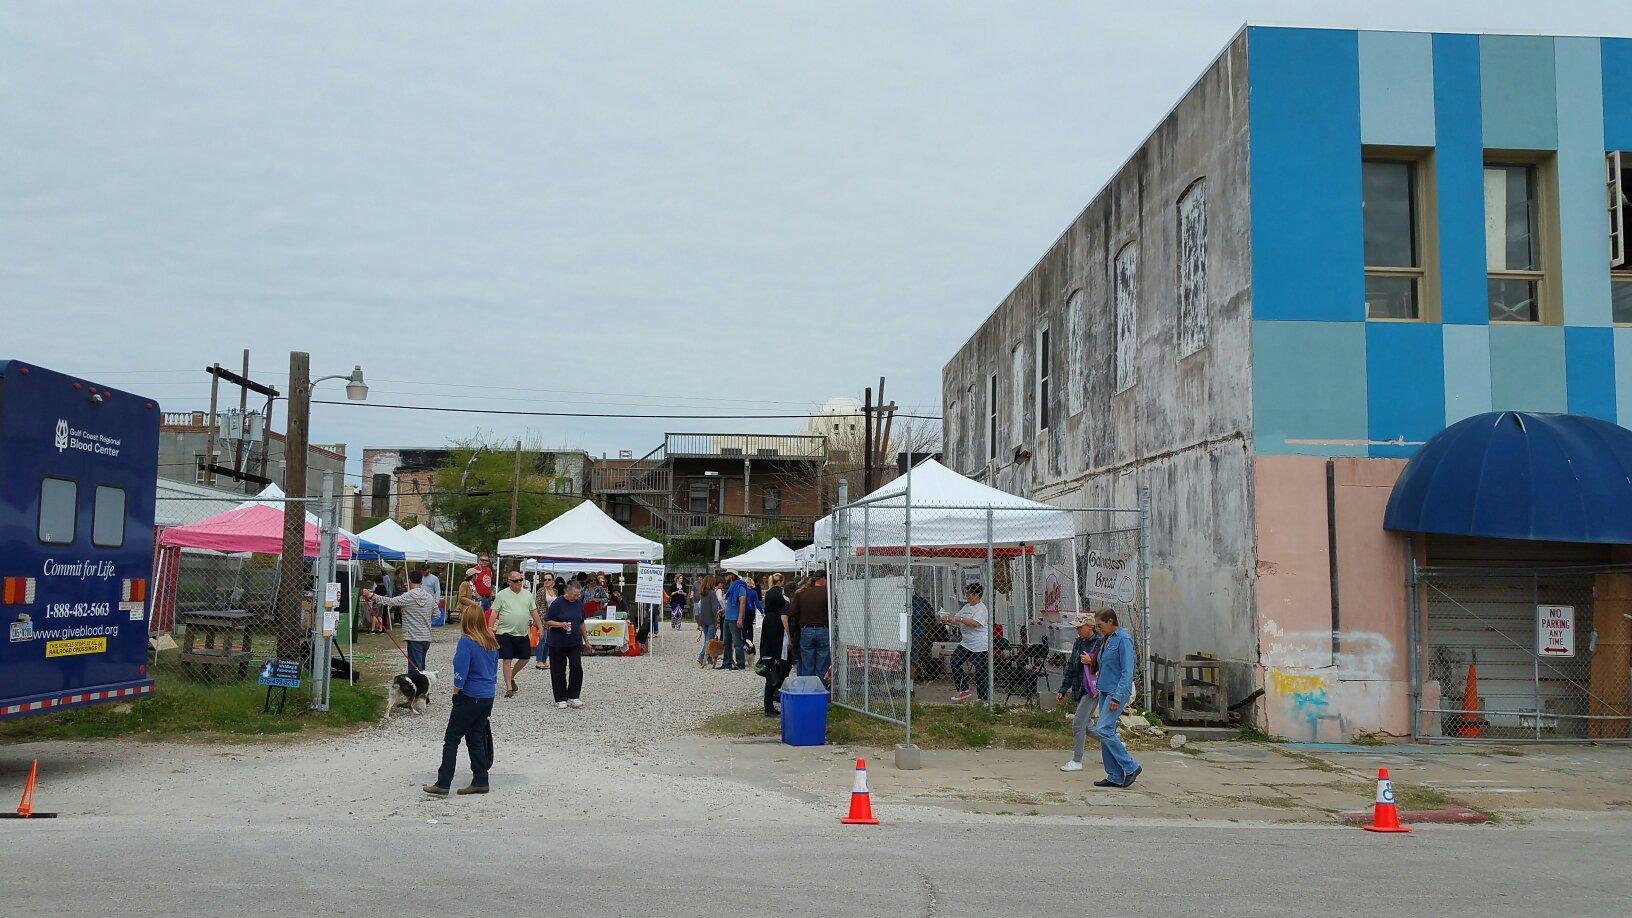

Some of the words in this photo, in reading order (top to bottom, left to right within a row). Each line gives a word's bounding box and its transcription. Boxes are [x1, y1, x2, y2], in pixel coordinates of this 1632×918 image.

[69, 427, 82, 437] Gulf
[82, 431, 99, 441] Coast
[99, 434, 121, 446] Regional
[70, 437, 93, 452] Blood
[94, 443, 120, 457] Center
[43, 558, 82, 577] Commit
[80, 560, 98, 580] for
[96, 560, 116, 580] Life.
[45, 602, 110, 619] 1-888-482-5663
[1549, 608, 1562, 618] NO
[1541, 619, 1570, 629] PARKING
[33, 625, 119, 639] www.giveblood.org
[1548, 638, 1564, 646] TIME
[49, 647, 72, 655] RAILROAD
[72, 645, 98, 653] CROSSINGS
